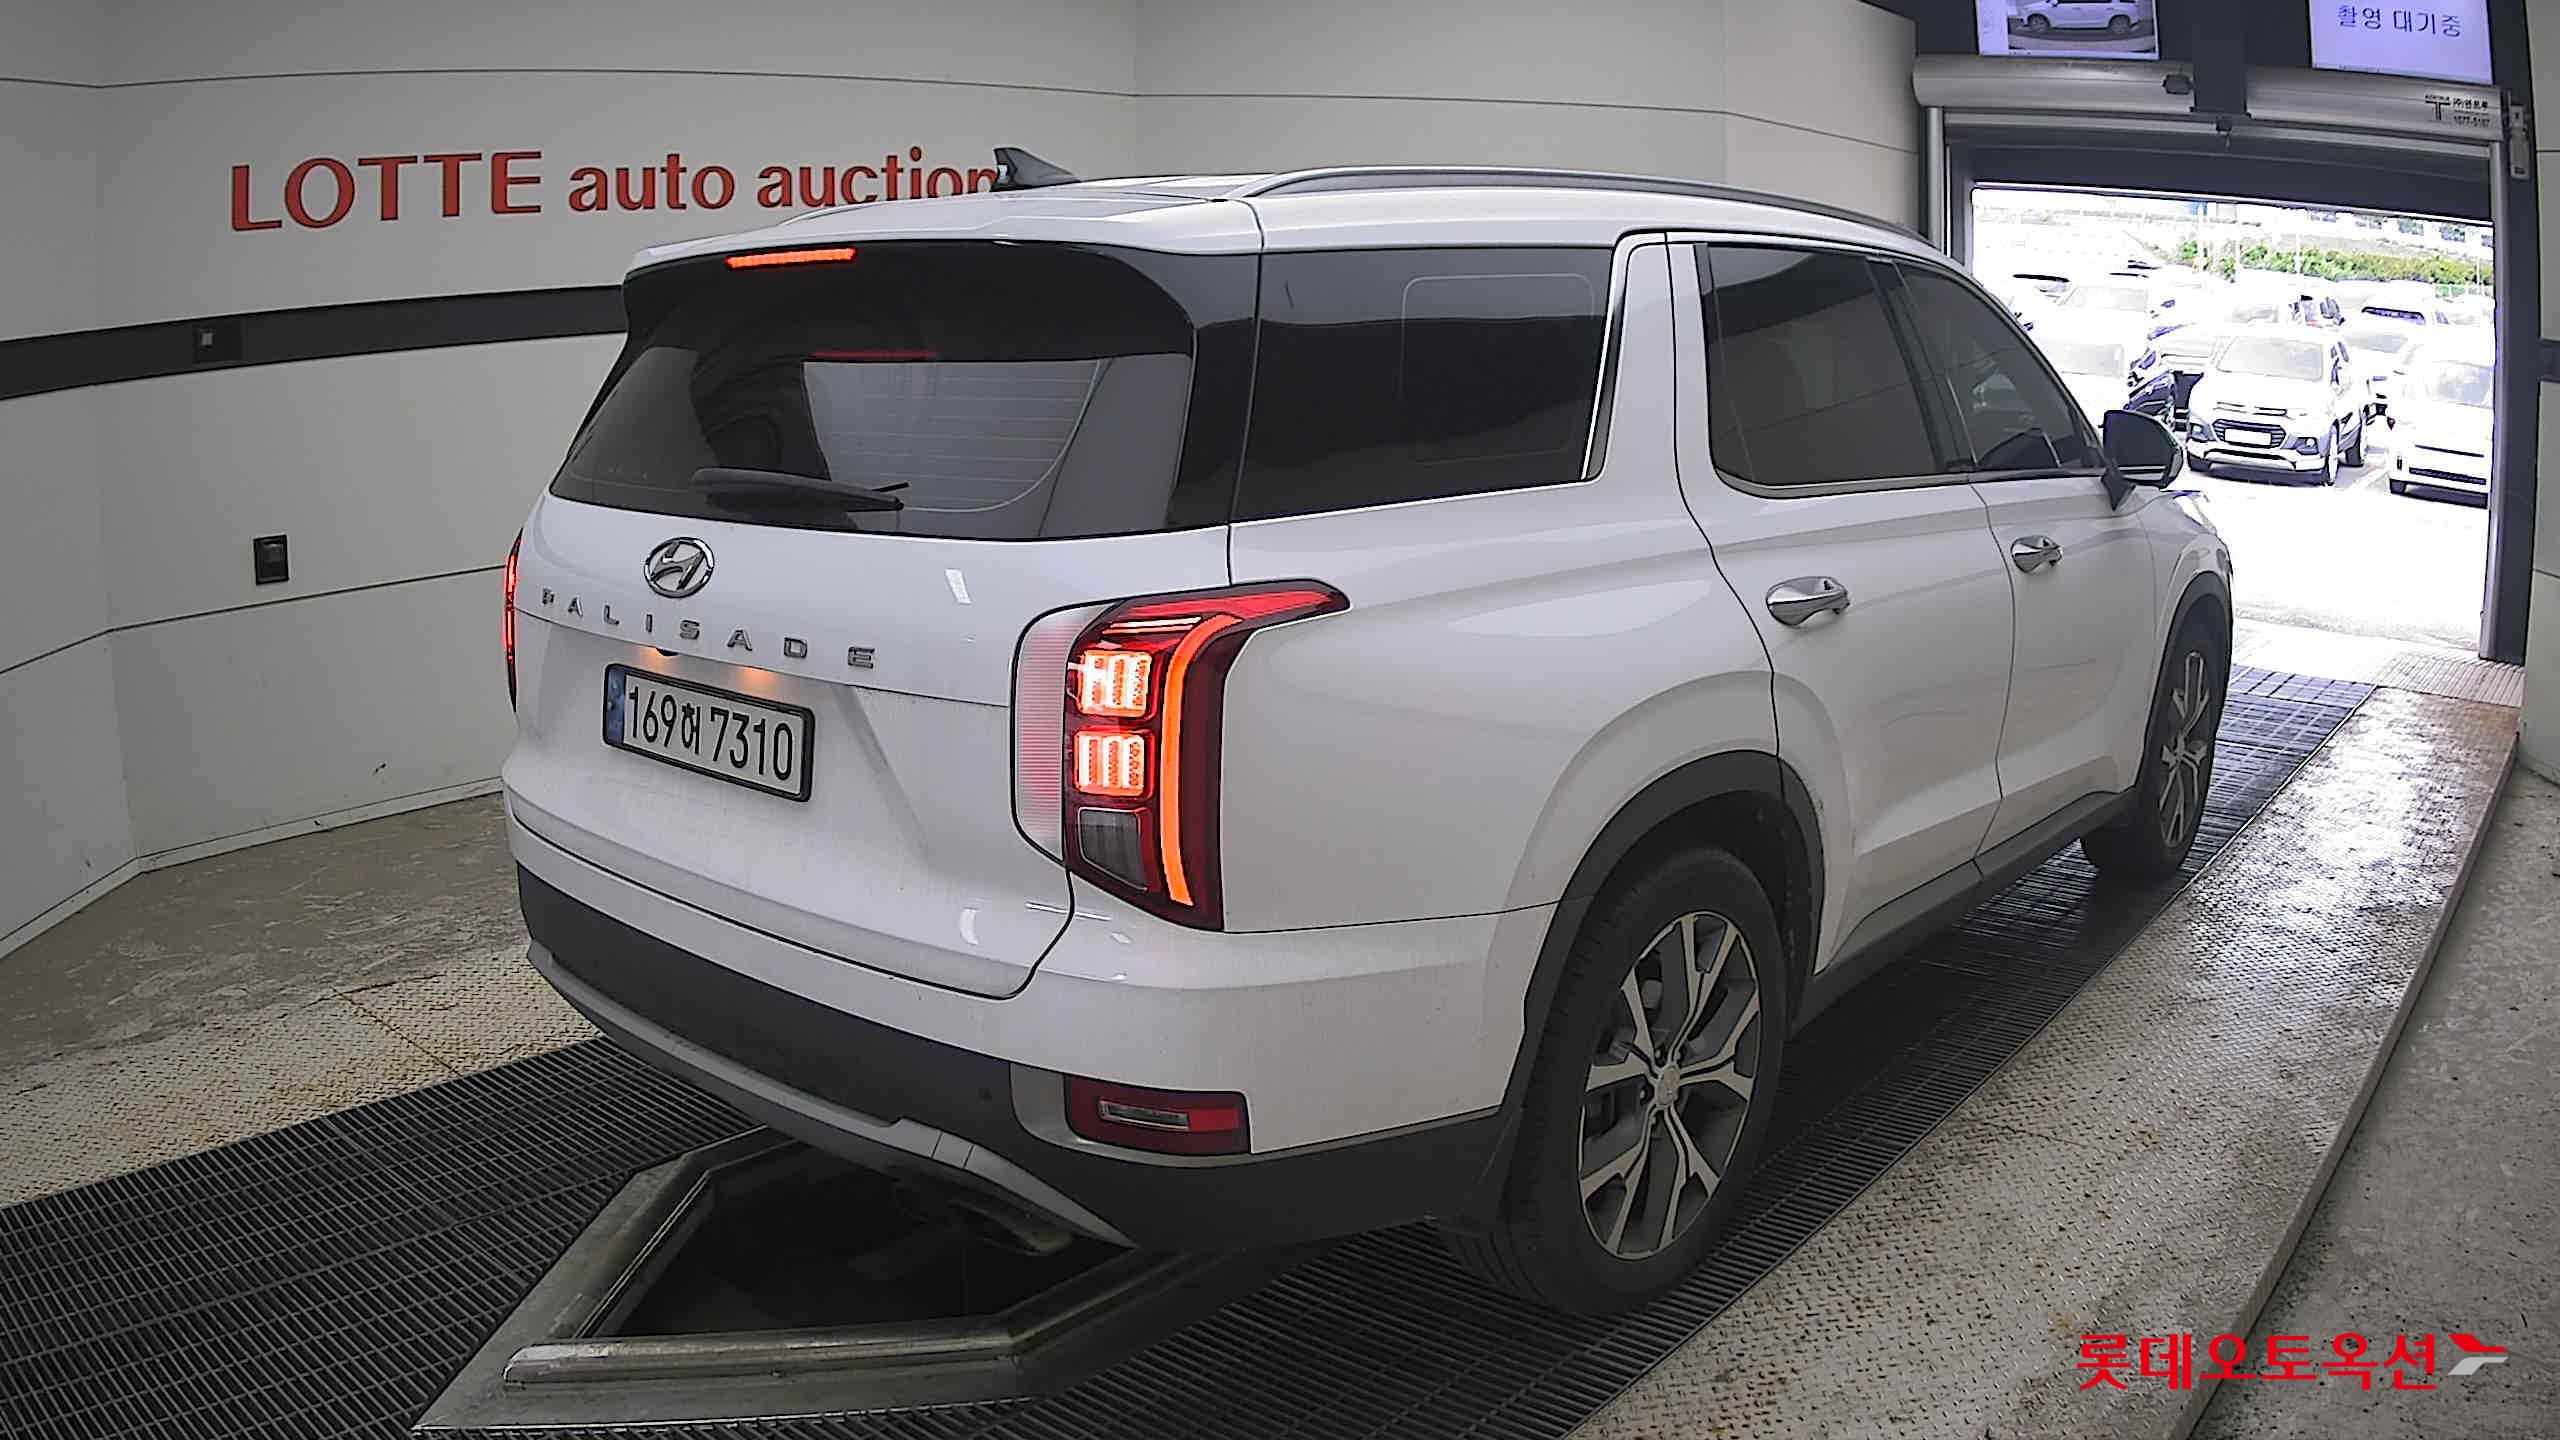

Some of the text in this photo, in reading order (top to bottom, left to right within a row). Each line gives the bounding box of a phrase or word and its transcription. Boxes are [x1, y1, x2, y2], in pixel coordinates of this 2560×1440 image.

[2337, 5, 2462, 38] 촬영 대기중
[231, 151, 542, 232] LOTTE
[568, 152, 736, 212] auto
[541, 586, 877, 670] PALISADE
